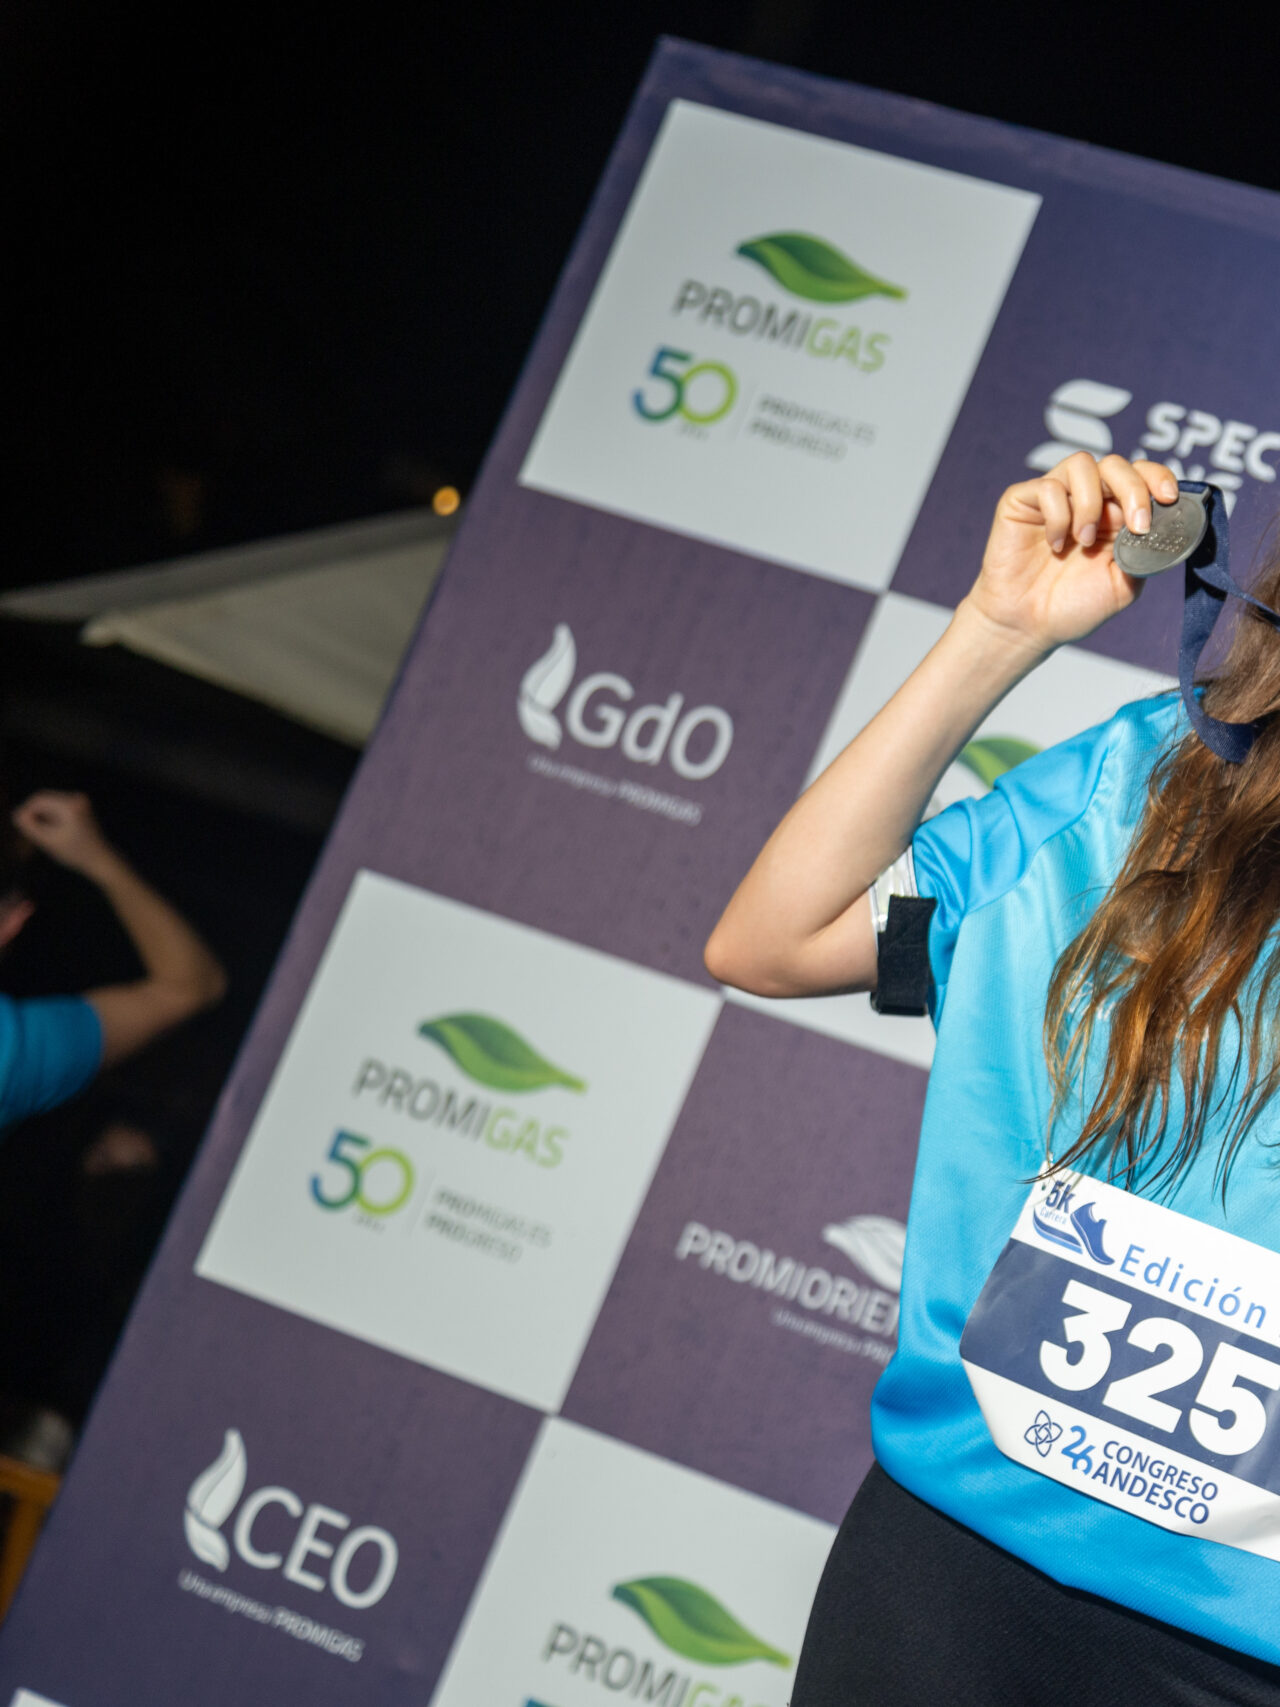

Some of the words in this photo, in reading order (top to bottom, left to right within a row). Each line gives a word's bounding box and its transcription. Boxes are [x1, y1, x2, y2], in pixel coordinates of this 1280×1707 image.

[673, 279, 892, 374] PROMIGAS
[632, 346, 738, 425] 50
[565, 671, 734, 782] GdO
[353, 1056, 570, 1169] PROMIGAS
[309, 1126, 415, 1215] 50
[1120, 1243, 1266, 1329] Edición
[1091, 1461, 1210, 1525] ANDESCO
[1103, 1440, 1219, 1501] CONGRESO
[234, 1485, 399, 1610] CEO
[543, 1621, 768, 1707] PROMIG
